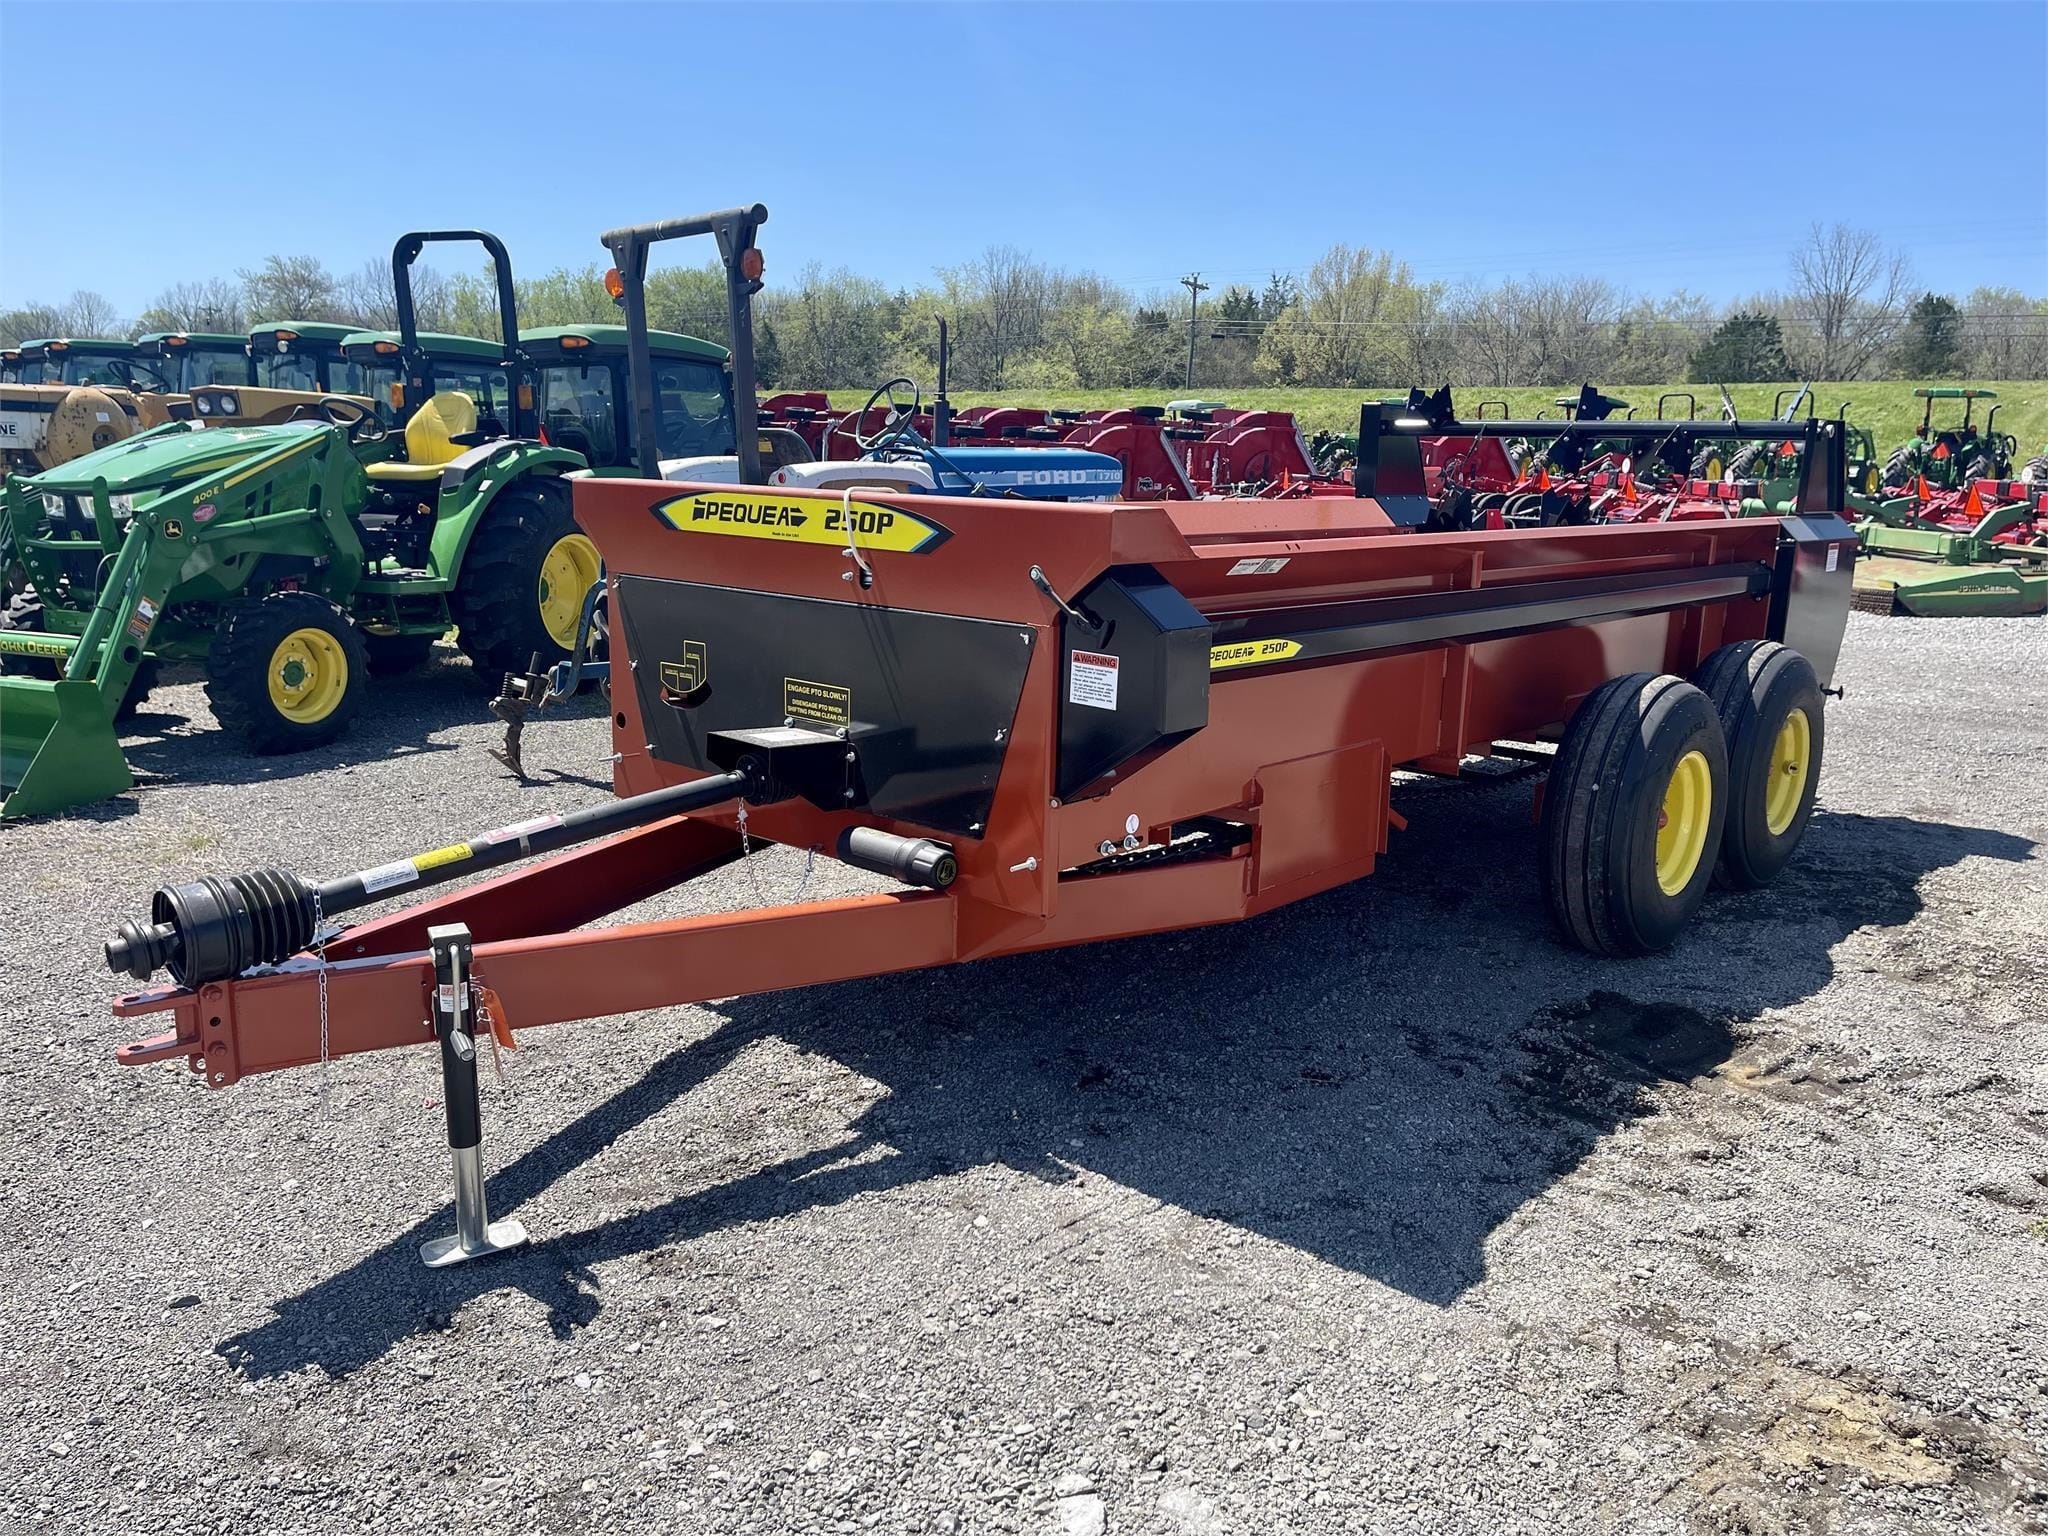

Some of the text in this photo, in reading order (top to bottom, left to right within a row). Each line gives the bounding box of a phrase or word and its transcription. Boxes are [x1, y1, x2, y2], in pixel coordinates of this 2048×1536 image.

[1017, 470, 1120, 485] FORD 1710
[705, 501, 894, 535] PEQUEA 250P
[0, 640, 68, 656] OHN DEERE
[1262, 642, 1288, 654] 250P
[1080, 654, 1116, 667] WARNING
[787, 684, 847, 701] ENGAGE PTO SLOWLY!
[792, 698, 842, 713] DISENGAGE PTO WHEN
[808, 709, 820, 717] FROM
[821, 712, 837, 720] CLEAN
